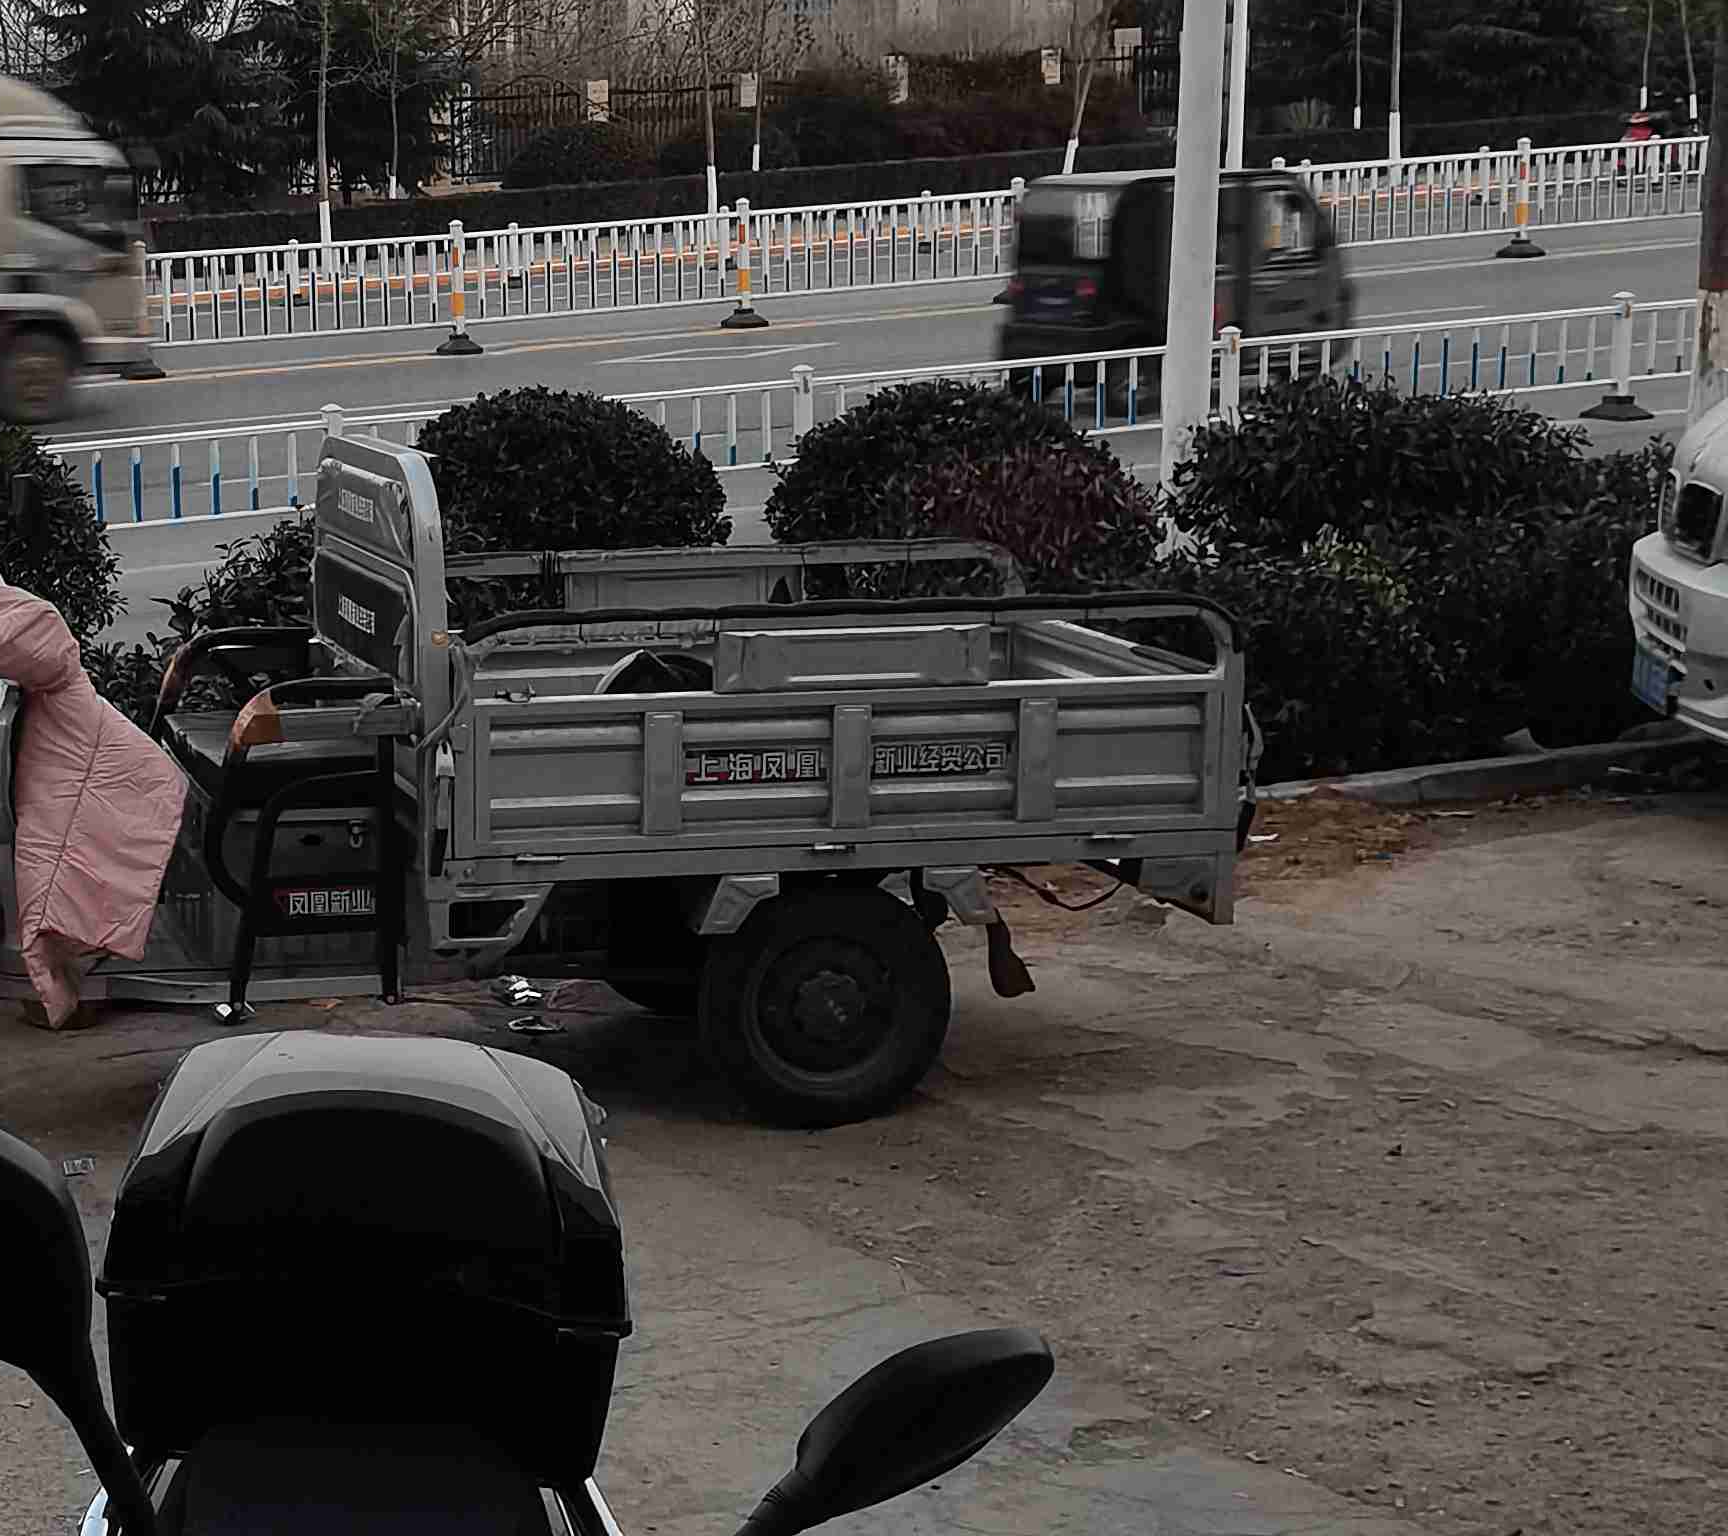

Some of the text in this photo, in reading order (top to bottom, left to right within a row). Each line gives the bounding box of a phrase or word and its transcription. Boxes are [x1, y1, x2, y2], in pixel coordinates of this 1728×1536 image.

[693, 743, 1007, 783] 上海凤凰 新业经贸公司
[288, 887, 376, 915] 凤凰新业
